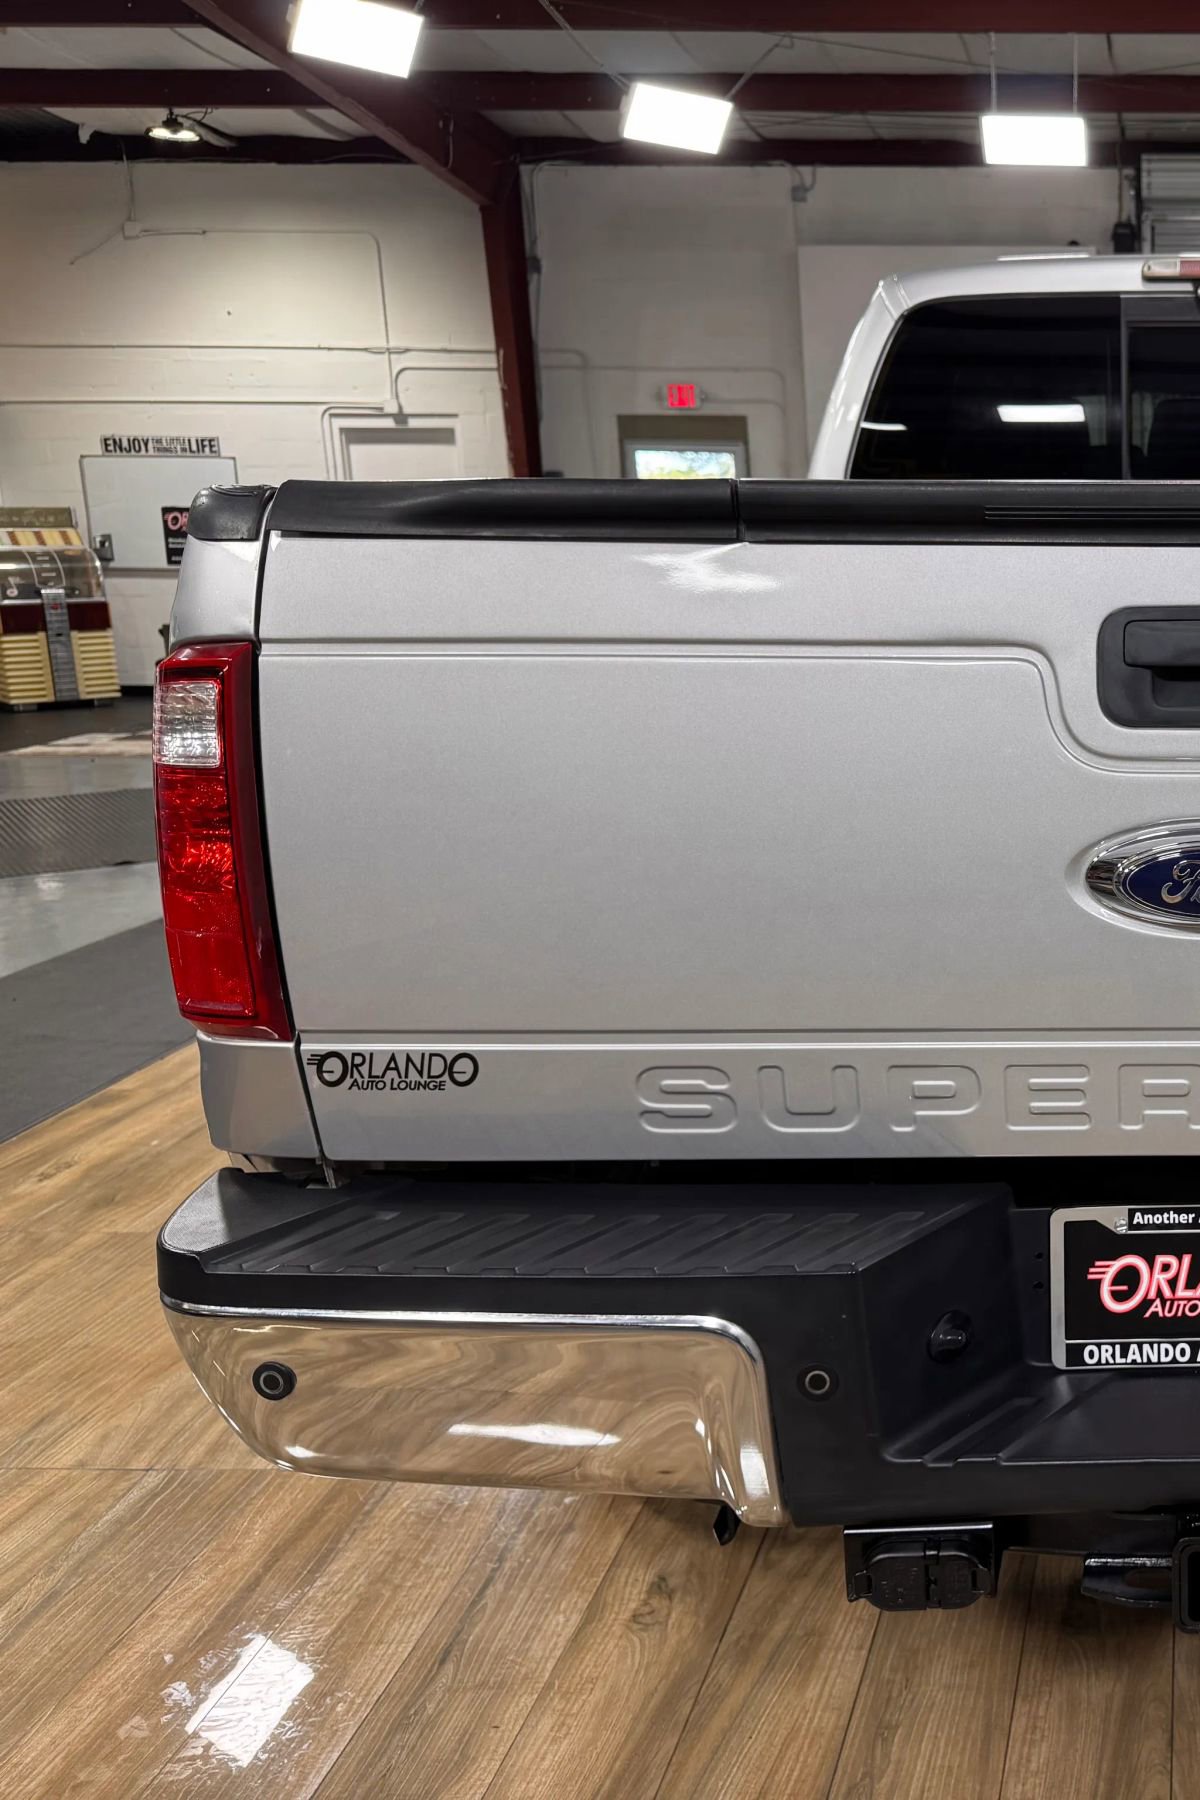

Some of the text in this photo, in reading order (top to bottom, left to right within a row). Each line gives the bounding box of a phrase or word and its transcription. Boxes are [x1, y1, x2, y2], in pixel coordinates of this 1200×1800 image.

[103, 437, 150, 454] ENJOY
[188, 438, 217, 454] LIFE
[307, 1051, 479, 1087] ORLANDO
[1132, 1211, 1195, 1226] Another
[1083, 1343, 1192, 1364] ORLANDO
